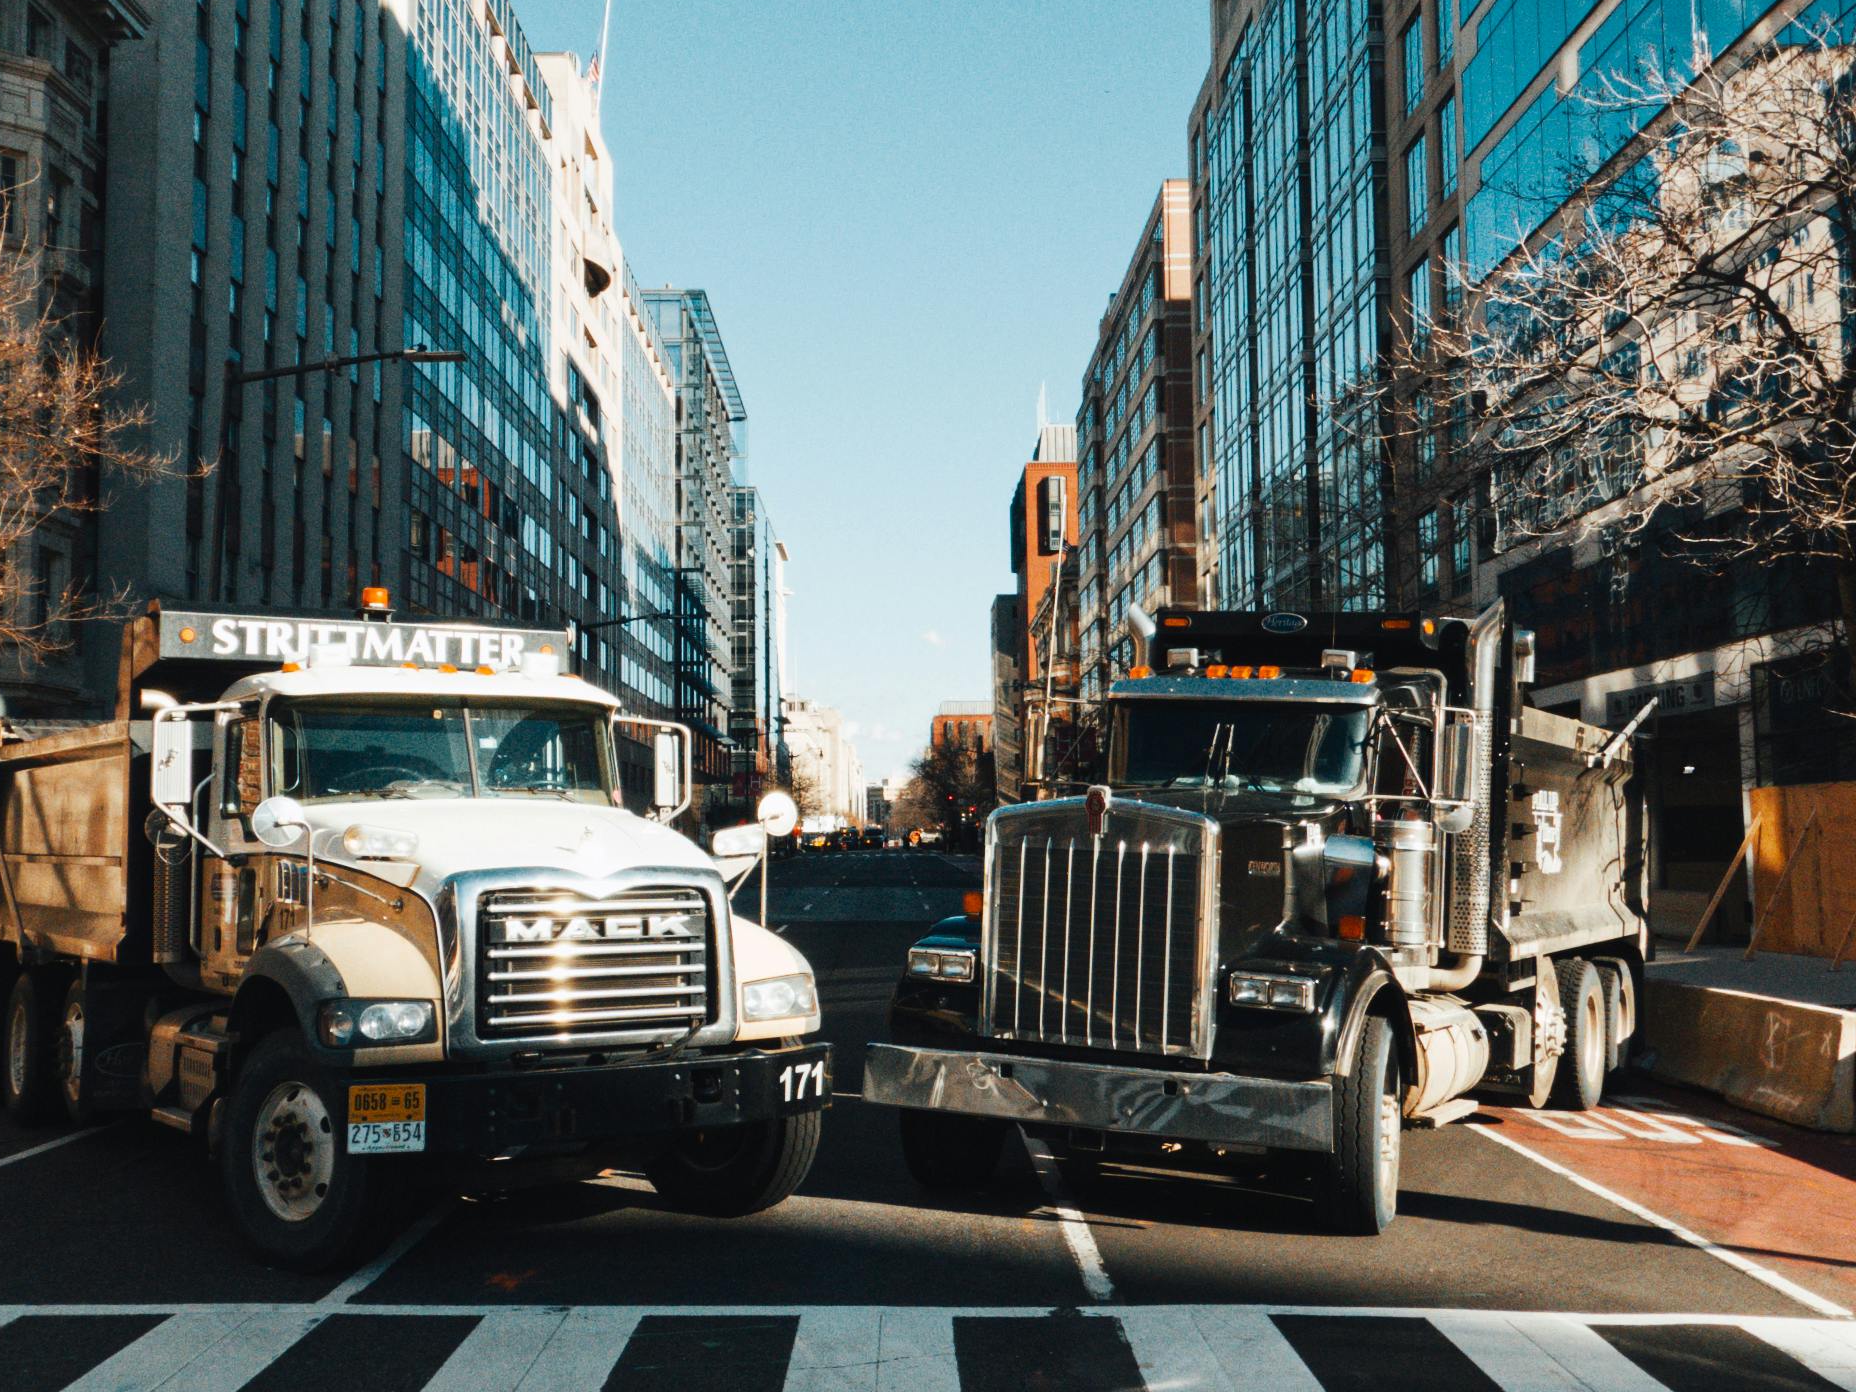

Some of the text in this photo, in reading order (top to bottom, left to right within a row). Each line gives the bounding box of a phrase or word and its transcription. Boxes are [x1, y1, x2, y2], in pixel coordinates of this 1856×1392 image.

[211, 618, 525, 665] STRITTMATTER
[505, 915, 691, 942] MACK
[779, 1060, 824, 1102] 171
[354, 1091, 420, 1111] 0658 65
[352, 1125, 381, 1144] 275
